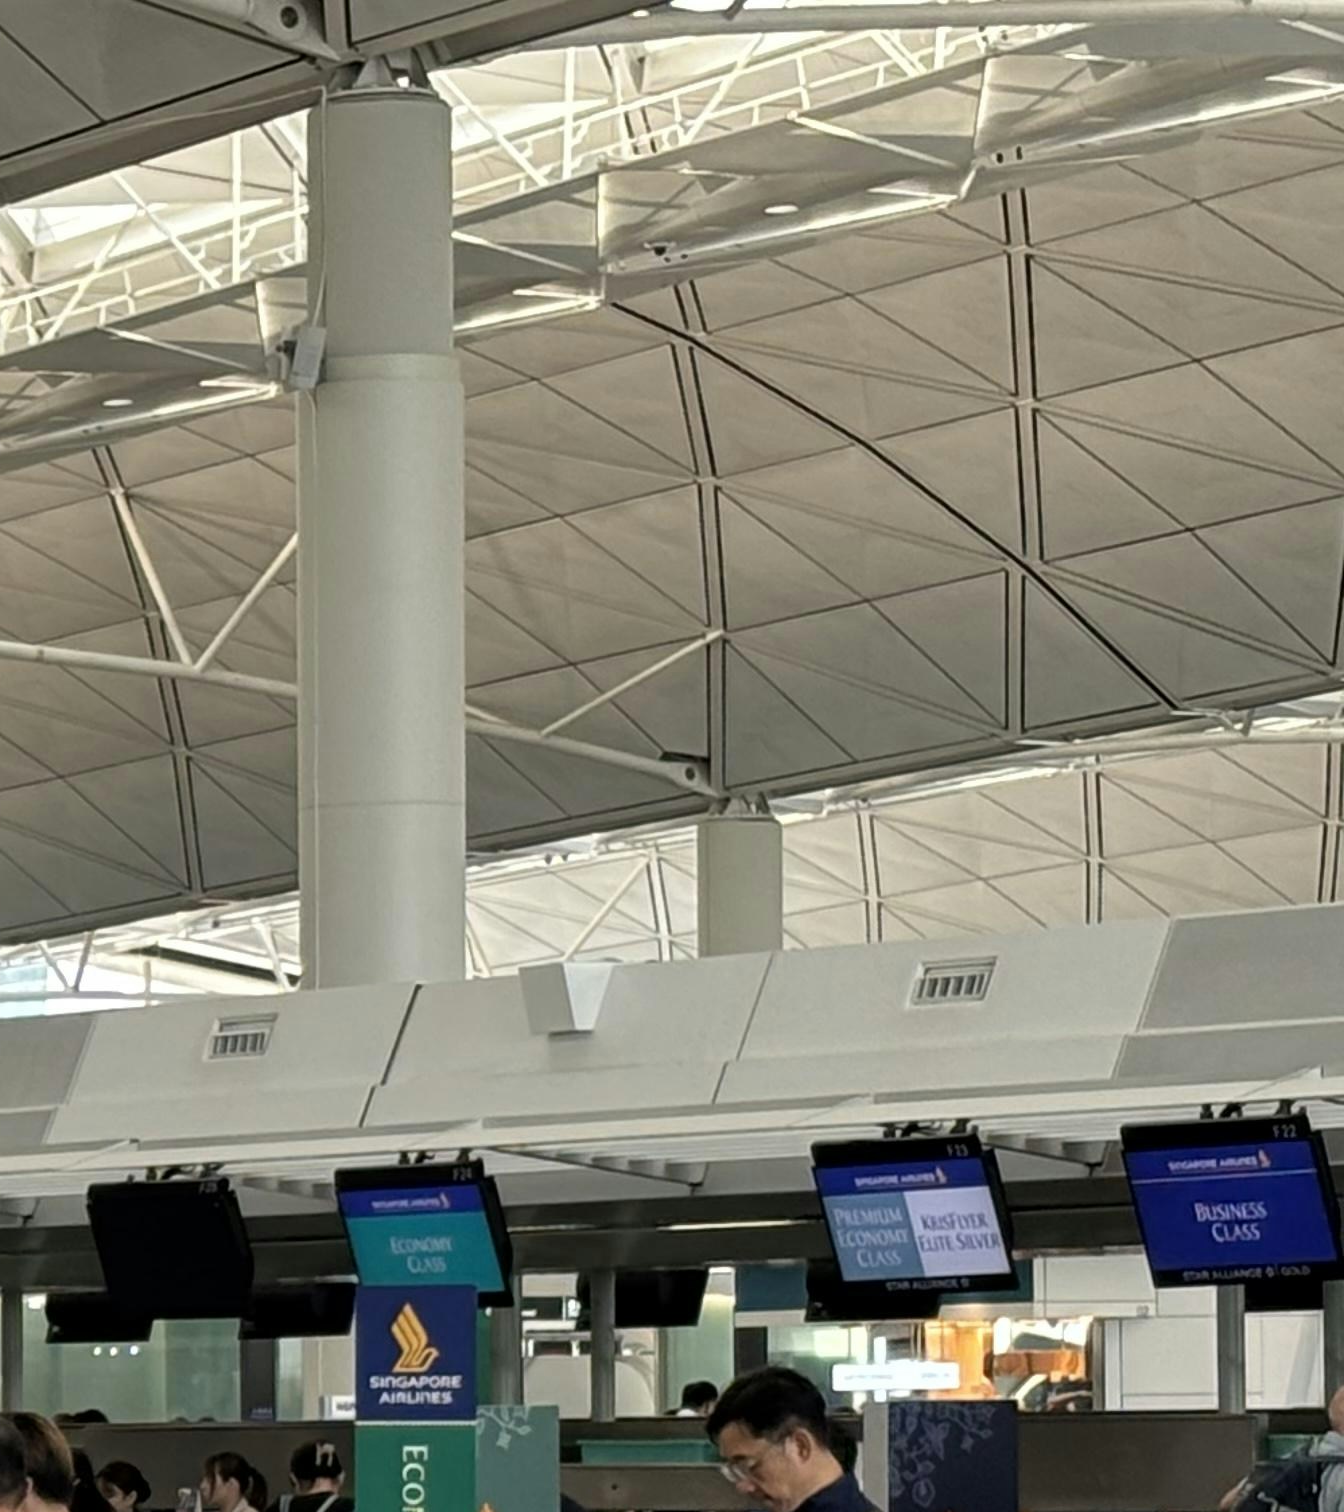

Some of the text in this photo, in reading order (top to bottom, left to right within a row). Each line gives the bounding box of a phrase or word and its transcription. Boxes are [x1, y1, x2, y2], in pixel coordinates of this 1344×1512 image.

[833, 1208, 903, 1227] PREMIUM
[1194, 1202, 1268, 1222] BUSINESS
[837, 1228, 910, 1248] ECONOMY
[1211, 1223, 1261, 1242] CLASS
[390, 1236, 453, 1254] ECONOMY
[918, 1232, 1002, 1252] ELITE SILVER
[407, 1256, 447, 1274] CLASS
[856, 1250, 902, 1268] CLASS
[369, 1375, 462, 1389] SINGAPORE
[378, 1391, 453, 1405] AIRLINES
